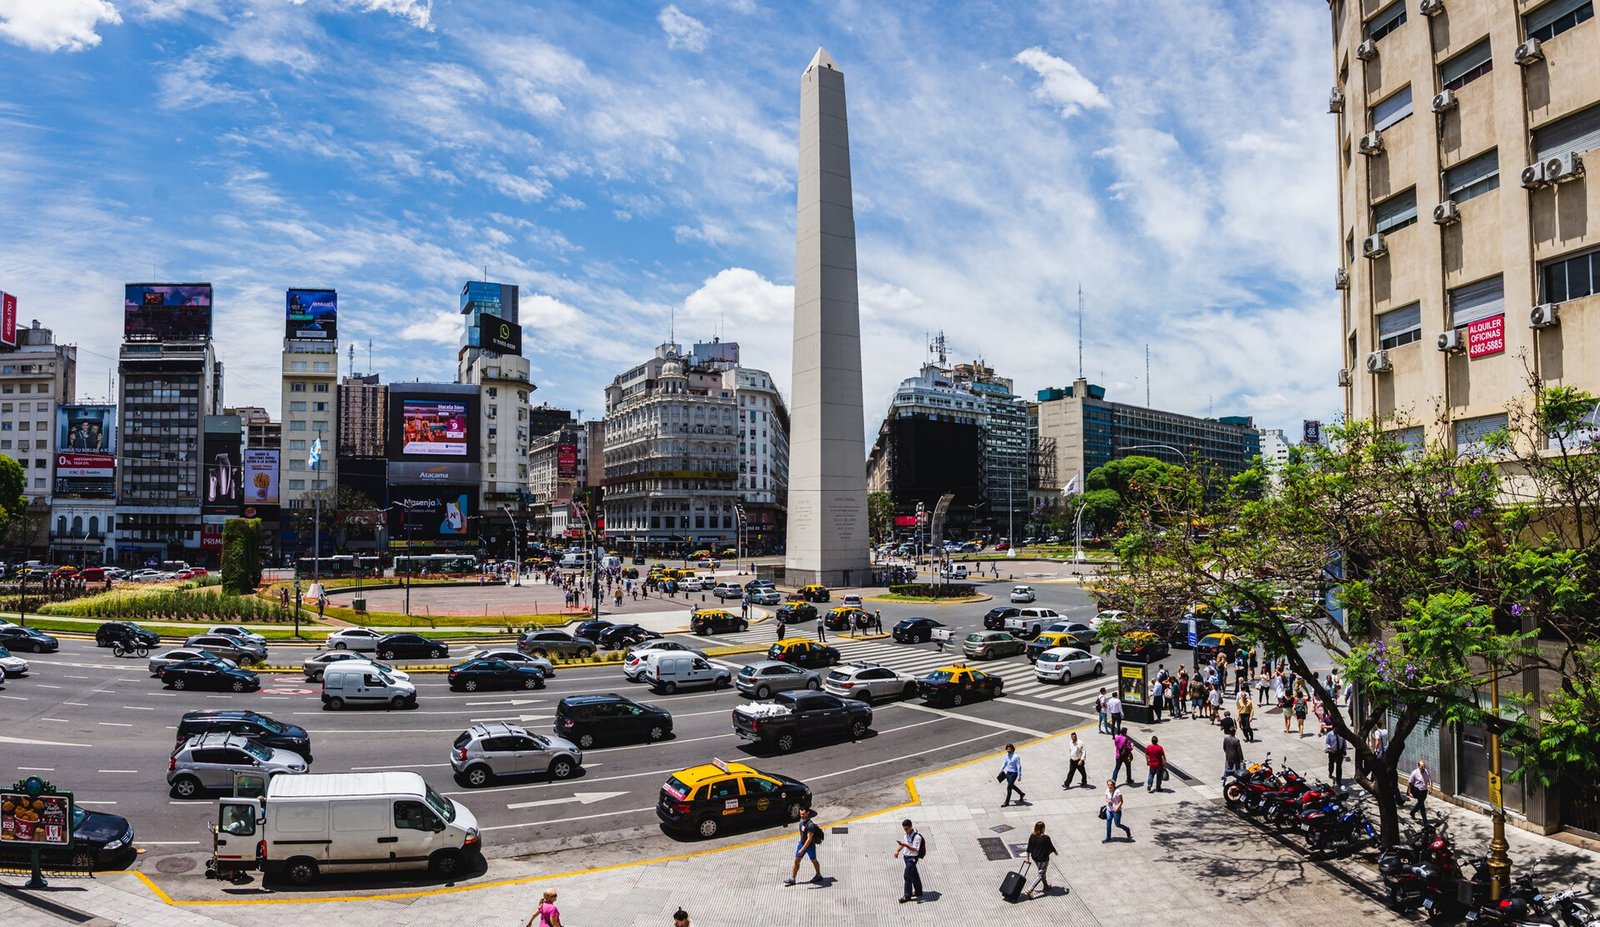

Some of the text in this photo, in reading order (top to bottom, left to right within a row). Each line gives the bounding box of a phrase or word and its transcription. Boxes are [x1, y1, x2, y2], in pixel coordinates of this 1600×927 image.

[1470, 319, 1501, 334] ALQUILER
[1471, 329, 1501, 343] OFICINAS
[59, 456, 72, 465] 0%
